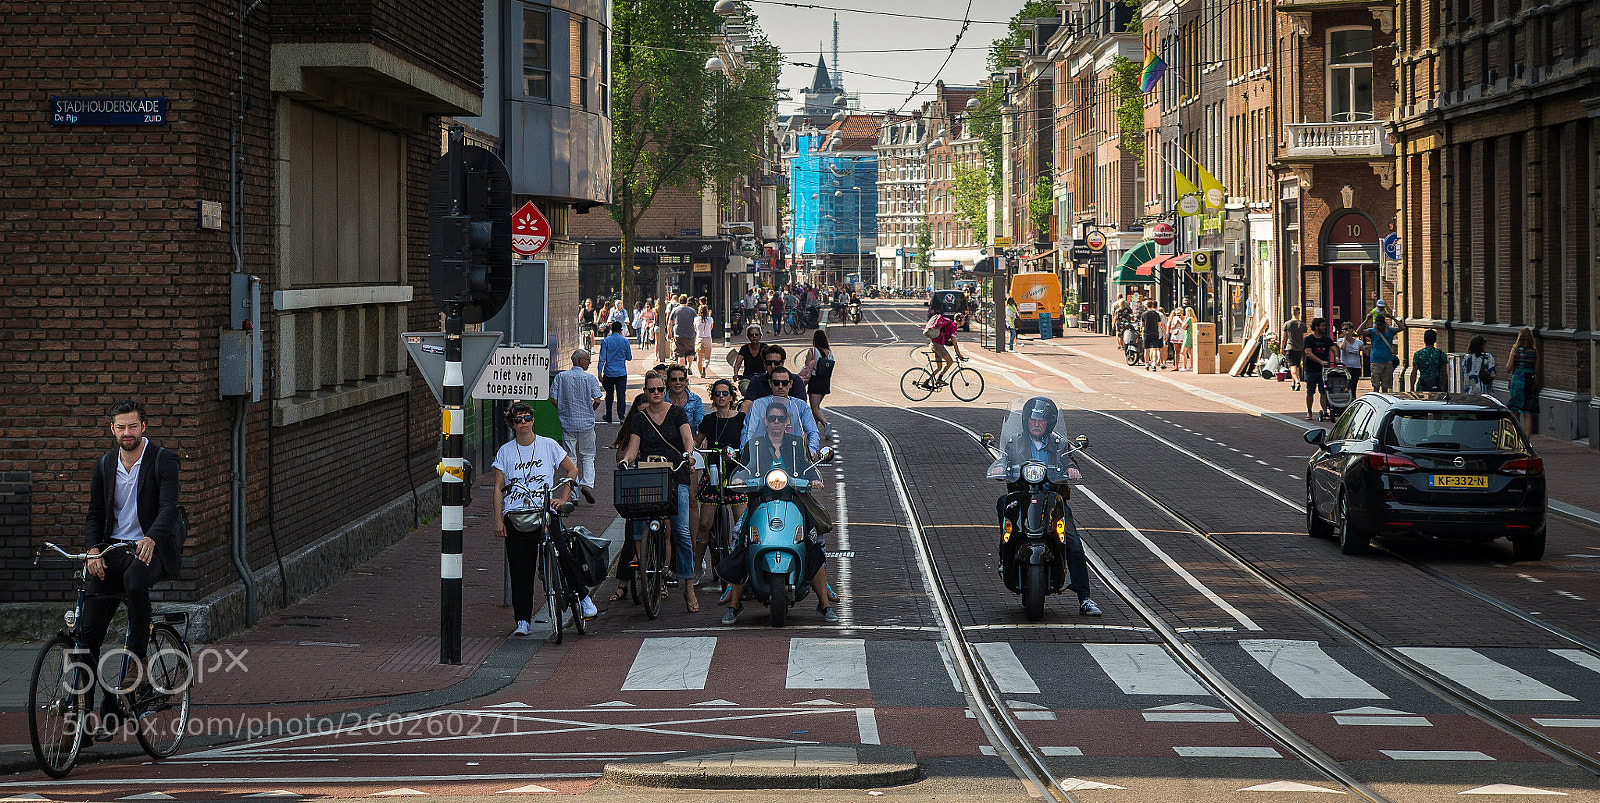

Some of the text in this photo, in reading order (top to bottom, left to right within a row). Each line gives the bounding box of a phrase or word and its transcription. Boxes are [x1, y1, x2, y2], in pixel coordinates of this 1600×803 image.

[56, 100, 159, 113] STADHOUDERSKADE
[1347, 224, 1361, 237] 10
[609, 245, 667, 254] O'NNELL'S
[500, 353, 550, 371] ontheffing
[493, 368, 533, 381] niet van
[487, 381, 539, 399] toepassing
[514, 459, 543, 471] more
[1438, 476, 1484, 486] KF-332-N
